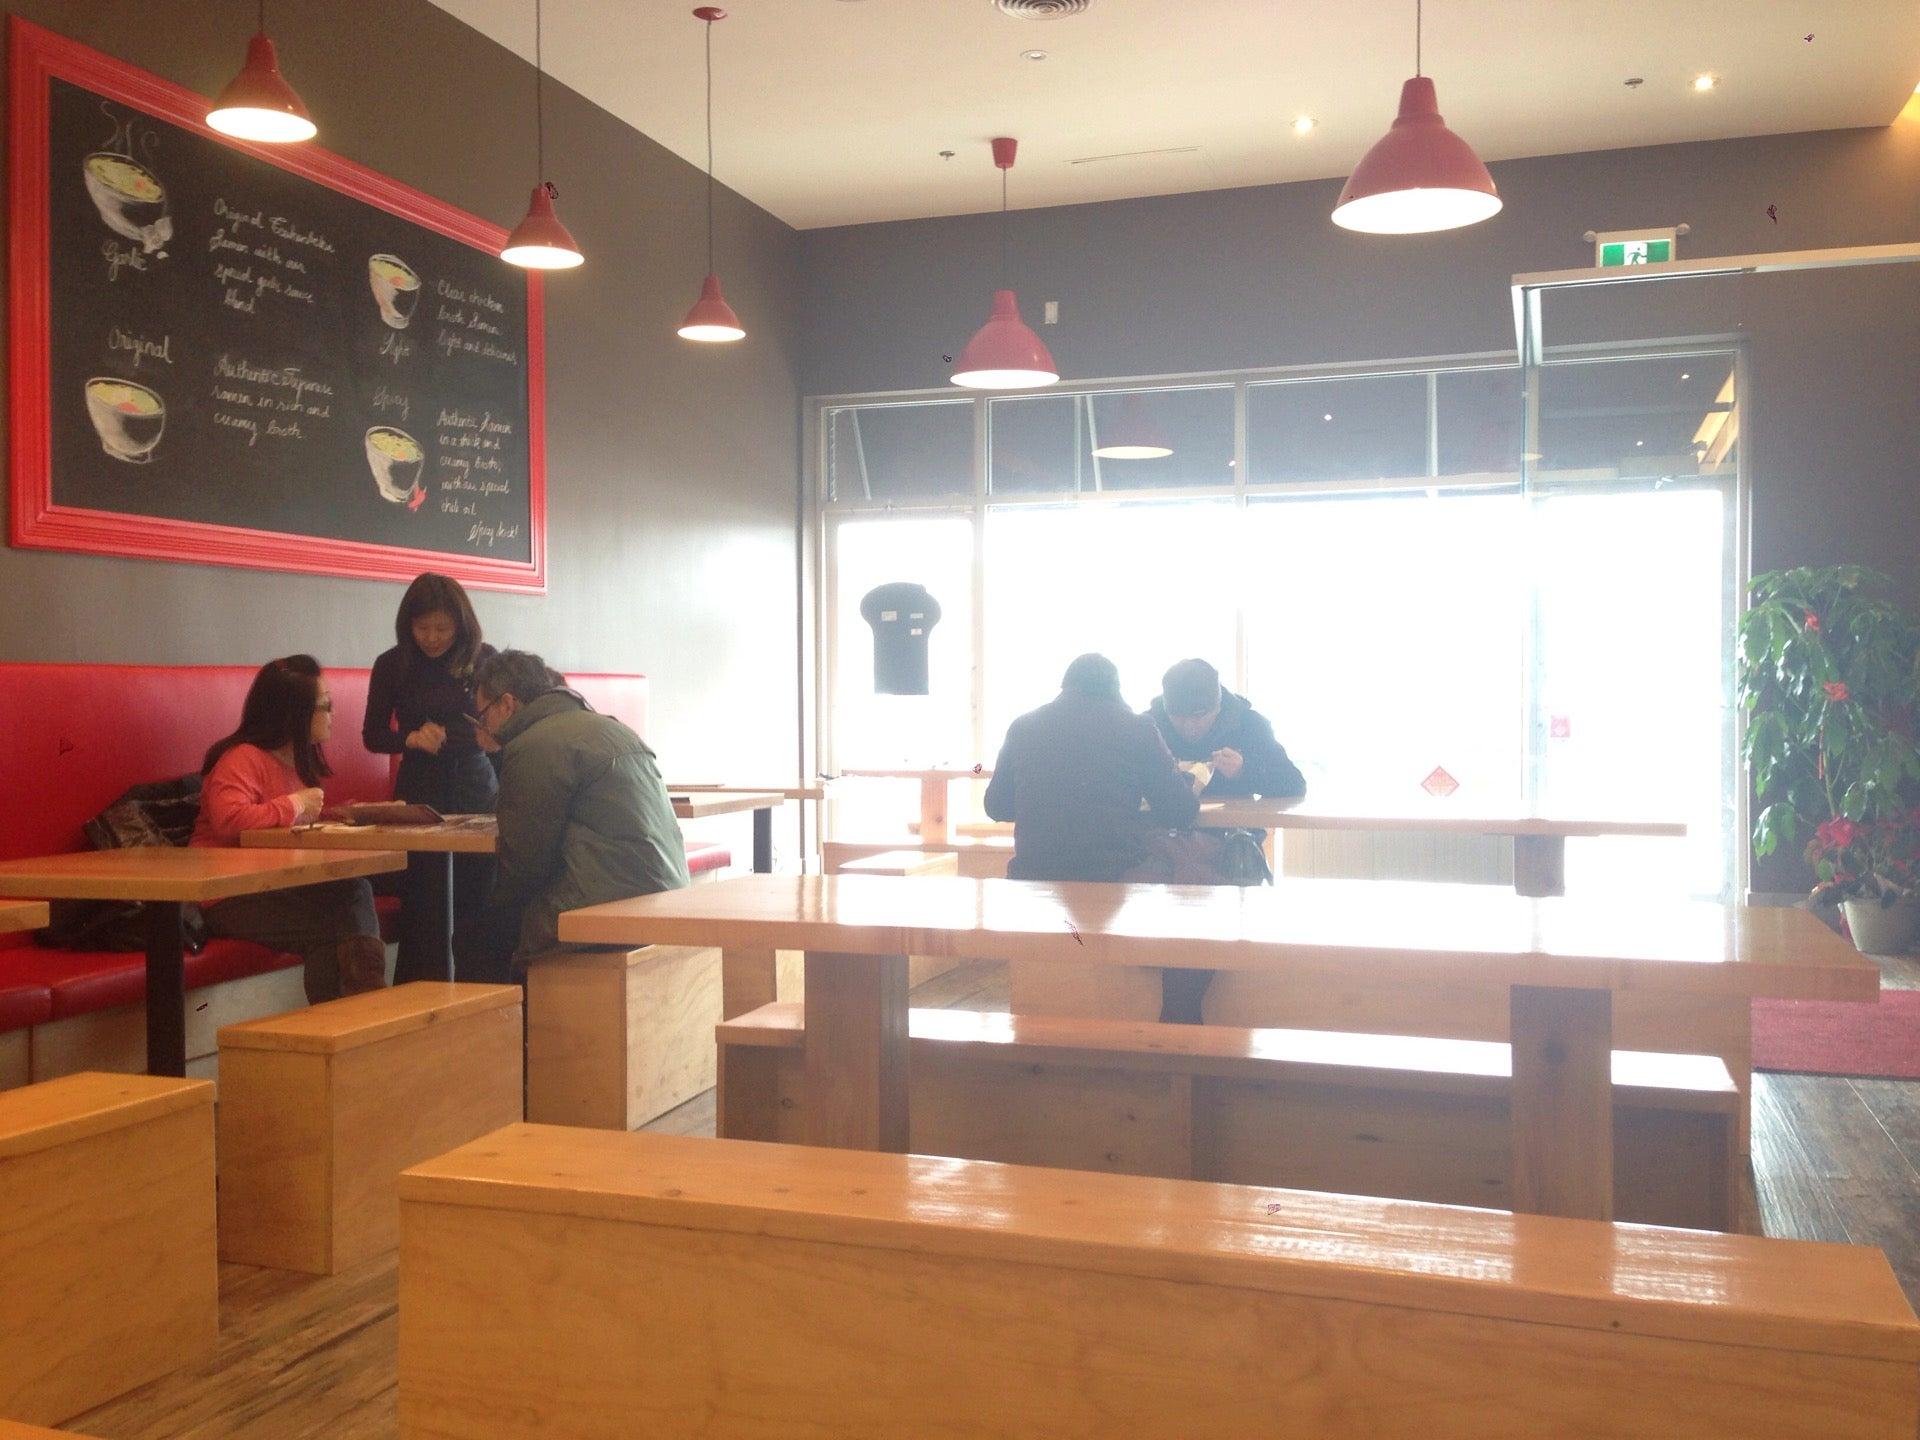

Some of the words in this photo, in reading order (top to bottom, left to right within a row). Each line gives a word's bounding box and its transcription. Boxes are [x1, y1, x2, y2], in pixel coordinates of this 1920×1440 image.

[108, 326, 174, 368] Original
[257, 396, 274, 408] in
[306, 405, 330, 418] and
